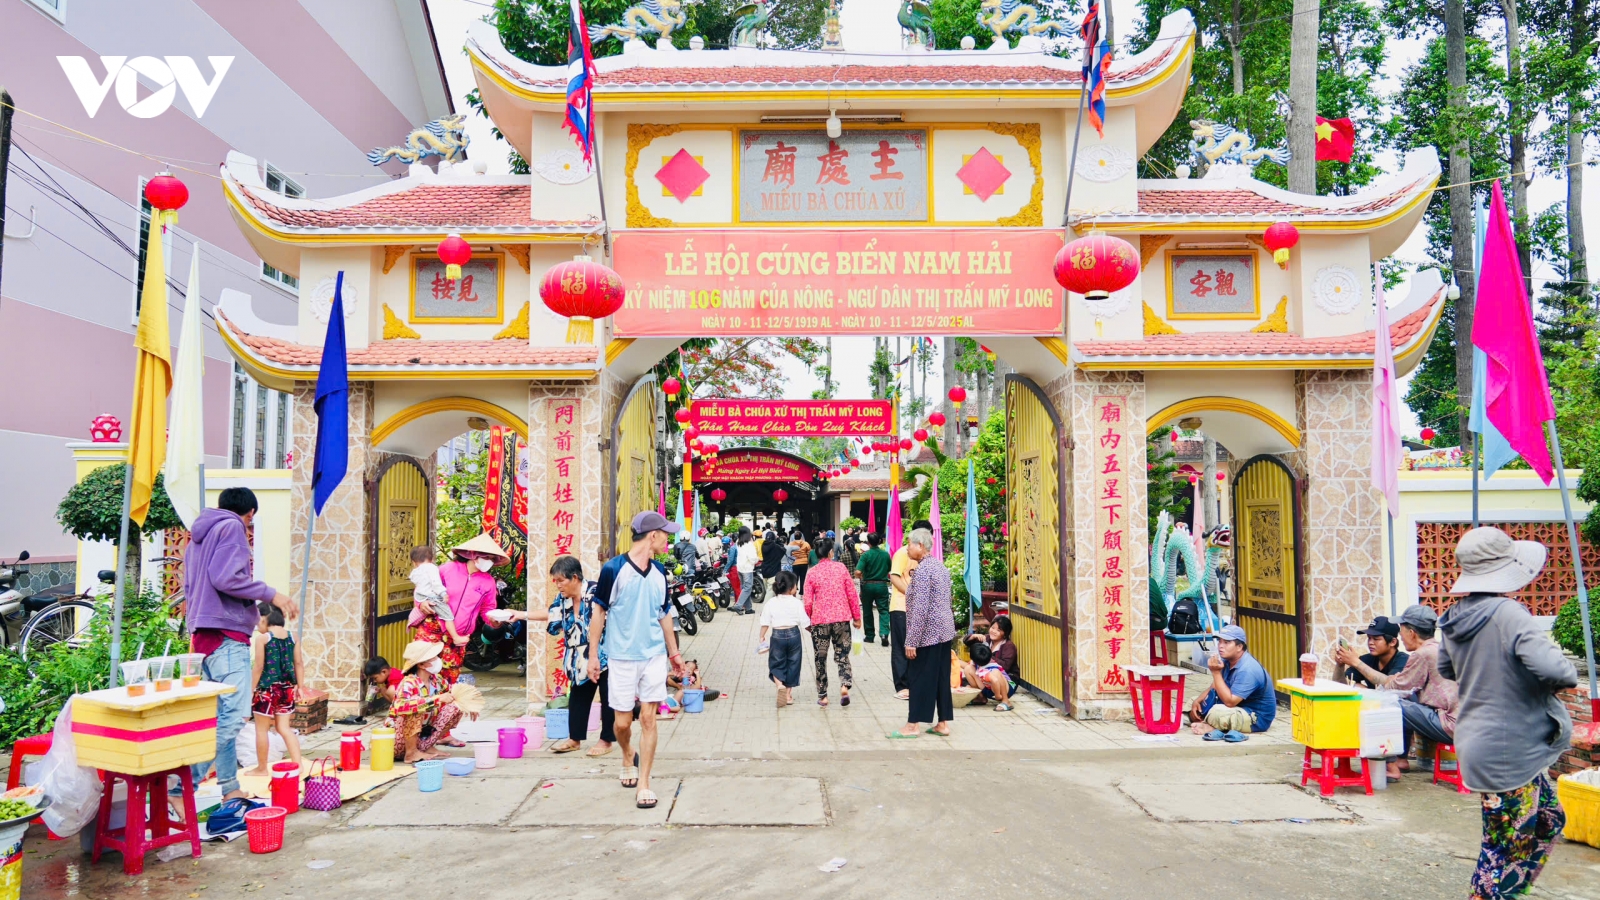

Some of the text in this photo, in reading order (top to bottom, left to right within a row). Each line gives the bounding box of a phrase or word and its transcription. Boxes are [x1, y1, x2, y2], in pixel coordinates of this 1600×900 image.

[807, 187, 829, 211] BÀ
[834, 187, 879, 211] CHÚA
[665, 239, 1012, 282] LỄ HỘI CÚNG BIỂN NAM HẢI
[1071, 246, 1097, 270] 福
[562, 271, 588, 295] 福
[624, 282, 643, 309] KỶ
[649, 285, 686, 313] NIỆM
[760, 282, 789, 309] CỦA
[794, 284, 834, 309] NÔNG
[848, 285, 879, 308] NGƯ
[881, 284, 911, 308] DÂN
[916, 289, 940, 312] THỊ
[944, 281, 984, 308] TRẤN
[988, 284, 1010, 308] MỸ
[1015, 288, 1053, 308] LONG
[701, 313, 726, 328] NGÀY
[730, 316, 741, 328] 10
[751, 316, 761, 328] 11
[820, 316, 832, 328] AL
[841, 313, 866, 328] NGÀY
[869, 316, 881, 328] 10
[890, 316, 901, 328] 11
[728, 404, 741, 417] BÀ
[744, 404, 771, 417] CHÚA
[774, 405, 788, 417] XỨ
[790, 407, 807, 419] THỊ
[810, 403, 835, 417] TRẤN
[838, 404, 853, 417] MỸ
[857, 406, 883, 417] LONG
[697, 420, 885, 434] Hân Hoan Chào Đón Quý Khách
